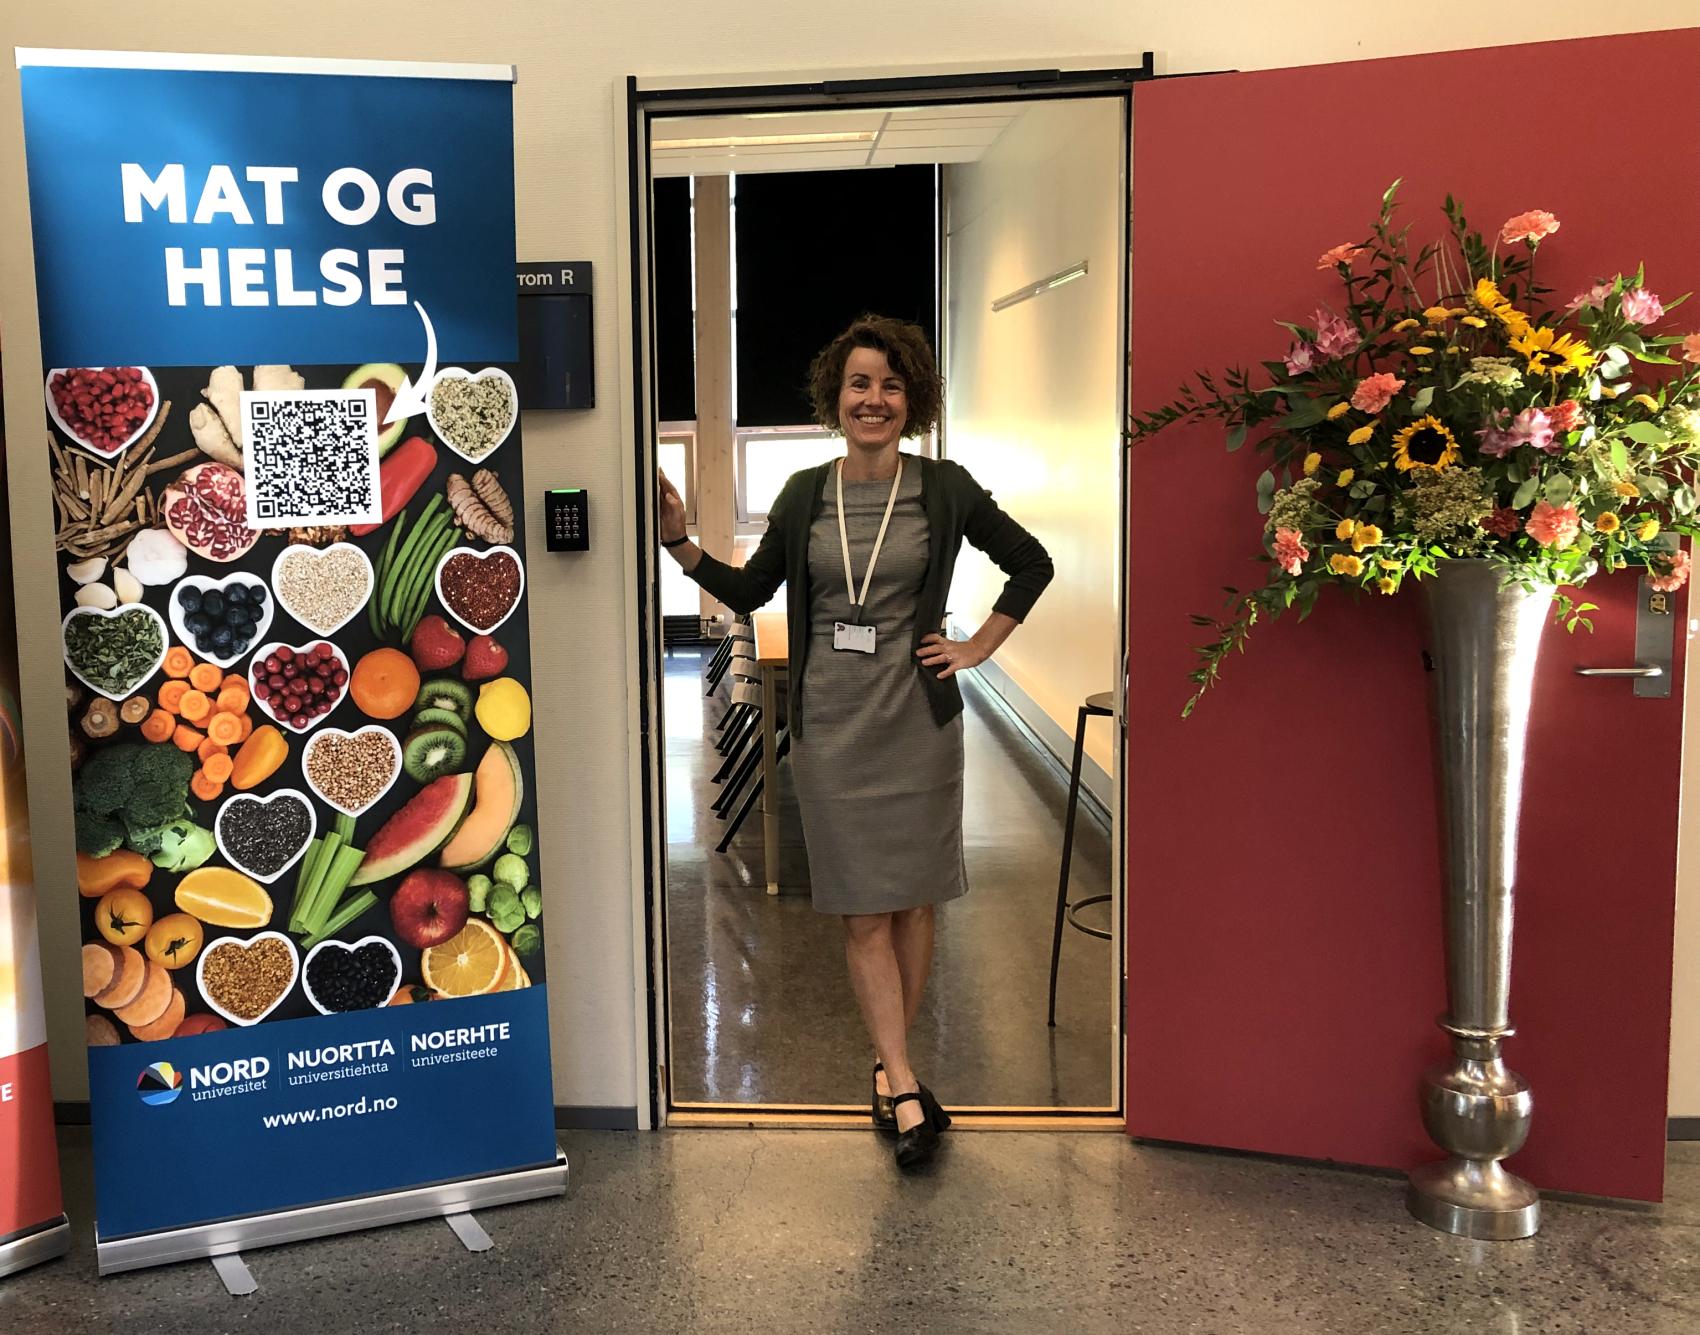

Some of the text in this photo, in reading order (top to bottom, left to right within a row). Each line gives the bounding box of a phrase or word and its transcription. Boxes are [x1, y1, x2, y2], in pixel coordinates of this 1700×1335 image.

[120, 163, 437, 226] MAT OG
[164, 247, 408, 307] HELSE
[561, 269, 574, 285] R
[411, 1022, 511, 1052] NOERHTE
[287, 1038, 396, 1070] NUORTTA
[411, 1046, 498, 1068] universiteete
[190, 1056, 270, 1089] NORD
[288, 1062, 389, 1086] universitiehtta
[191, 1078, 267, 1102] universitet
[262, 1095, 398, 1129] www.nord.no
